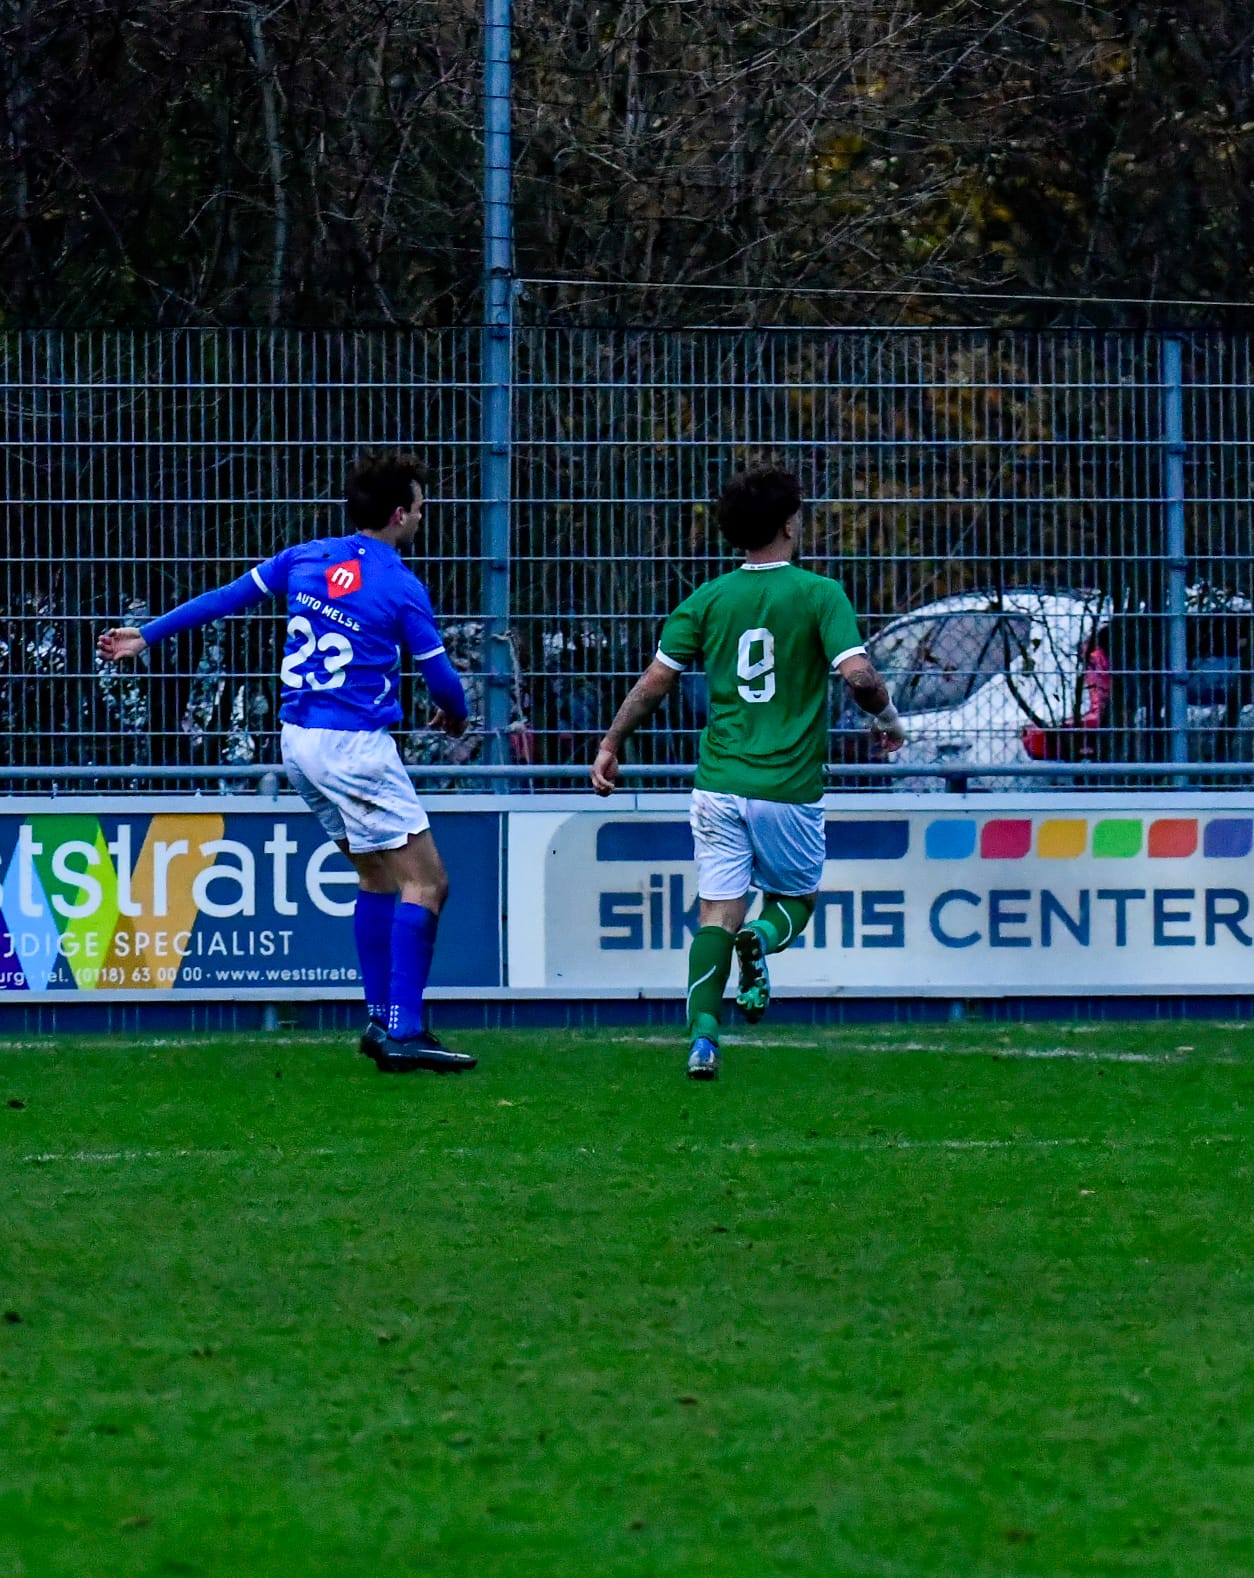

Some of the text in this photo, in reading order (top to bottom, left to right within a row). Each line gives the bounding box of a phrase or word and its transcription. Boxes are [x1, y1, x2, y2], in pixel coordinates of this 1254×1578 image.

[296, 591, 361, 632] AUTO MELSE
[280, 615, 354, 691] 23
[737, 628, 776, 703] 9
[0, 823, 360, 918] tstrate
[114, 930, 294, 958] SPECIALIST
[600, 873, 1253, 950] sikns CENTER
[76, 967, 126, 985] (0118)
[131, 967, 151, 982] 63
[157, 967, 177, 982] 00
[183, 966, 202, 982] 00
